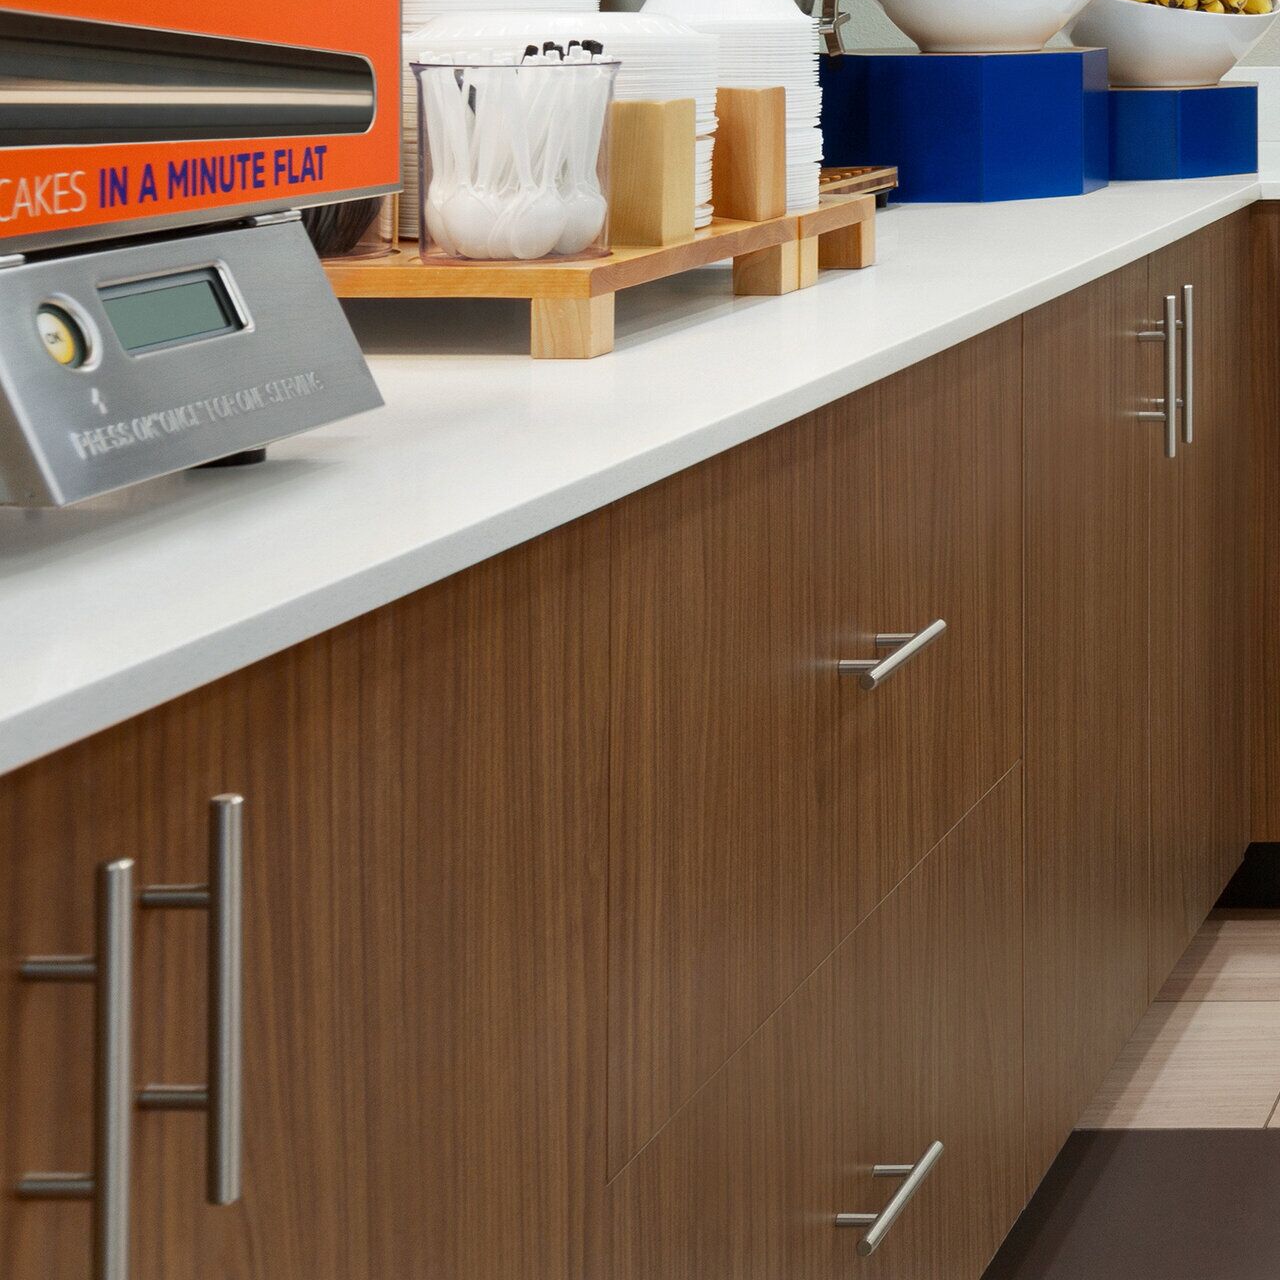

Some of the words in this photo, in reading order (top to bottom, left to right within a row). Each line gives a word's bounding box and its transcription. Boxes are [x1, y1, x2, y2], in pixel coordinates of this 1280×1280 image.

[99, 166, 128, 209] IN
[138, 163, 158, 204] A
[168, 151, 265, 200] MINUTE
[273, 145, 328, 186] FLAT
